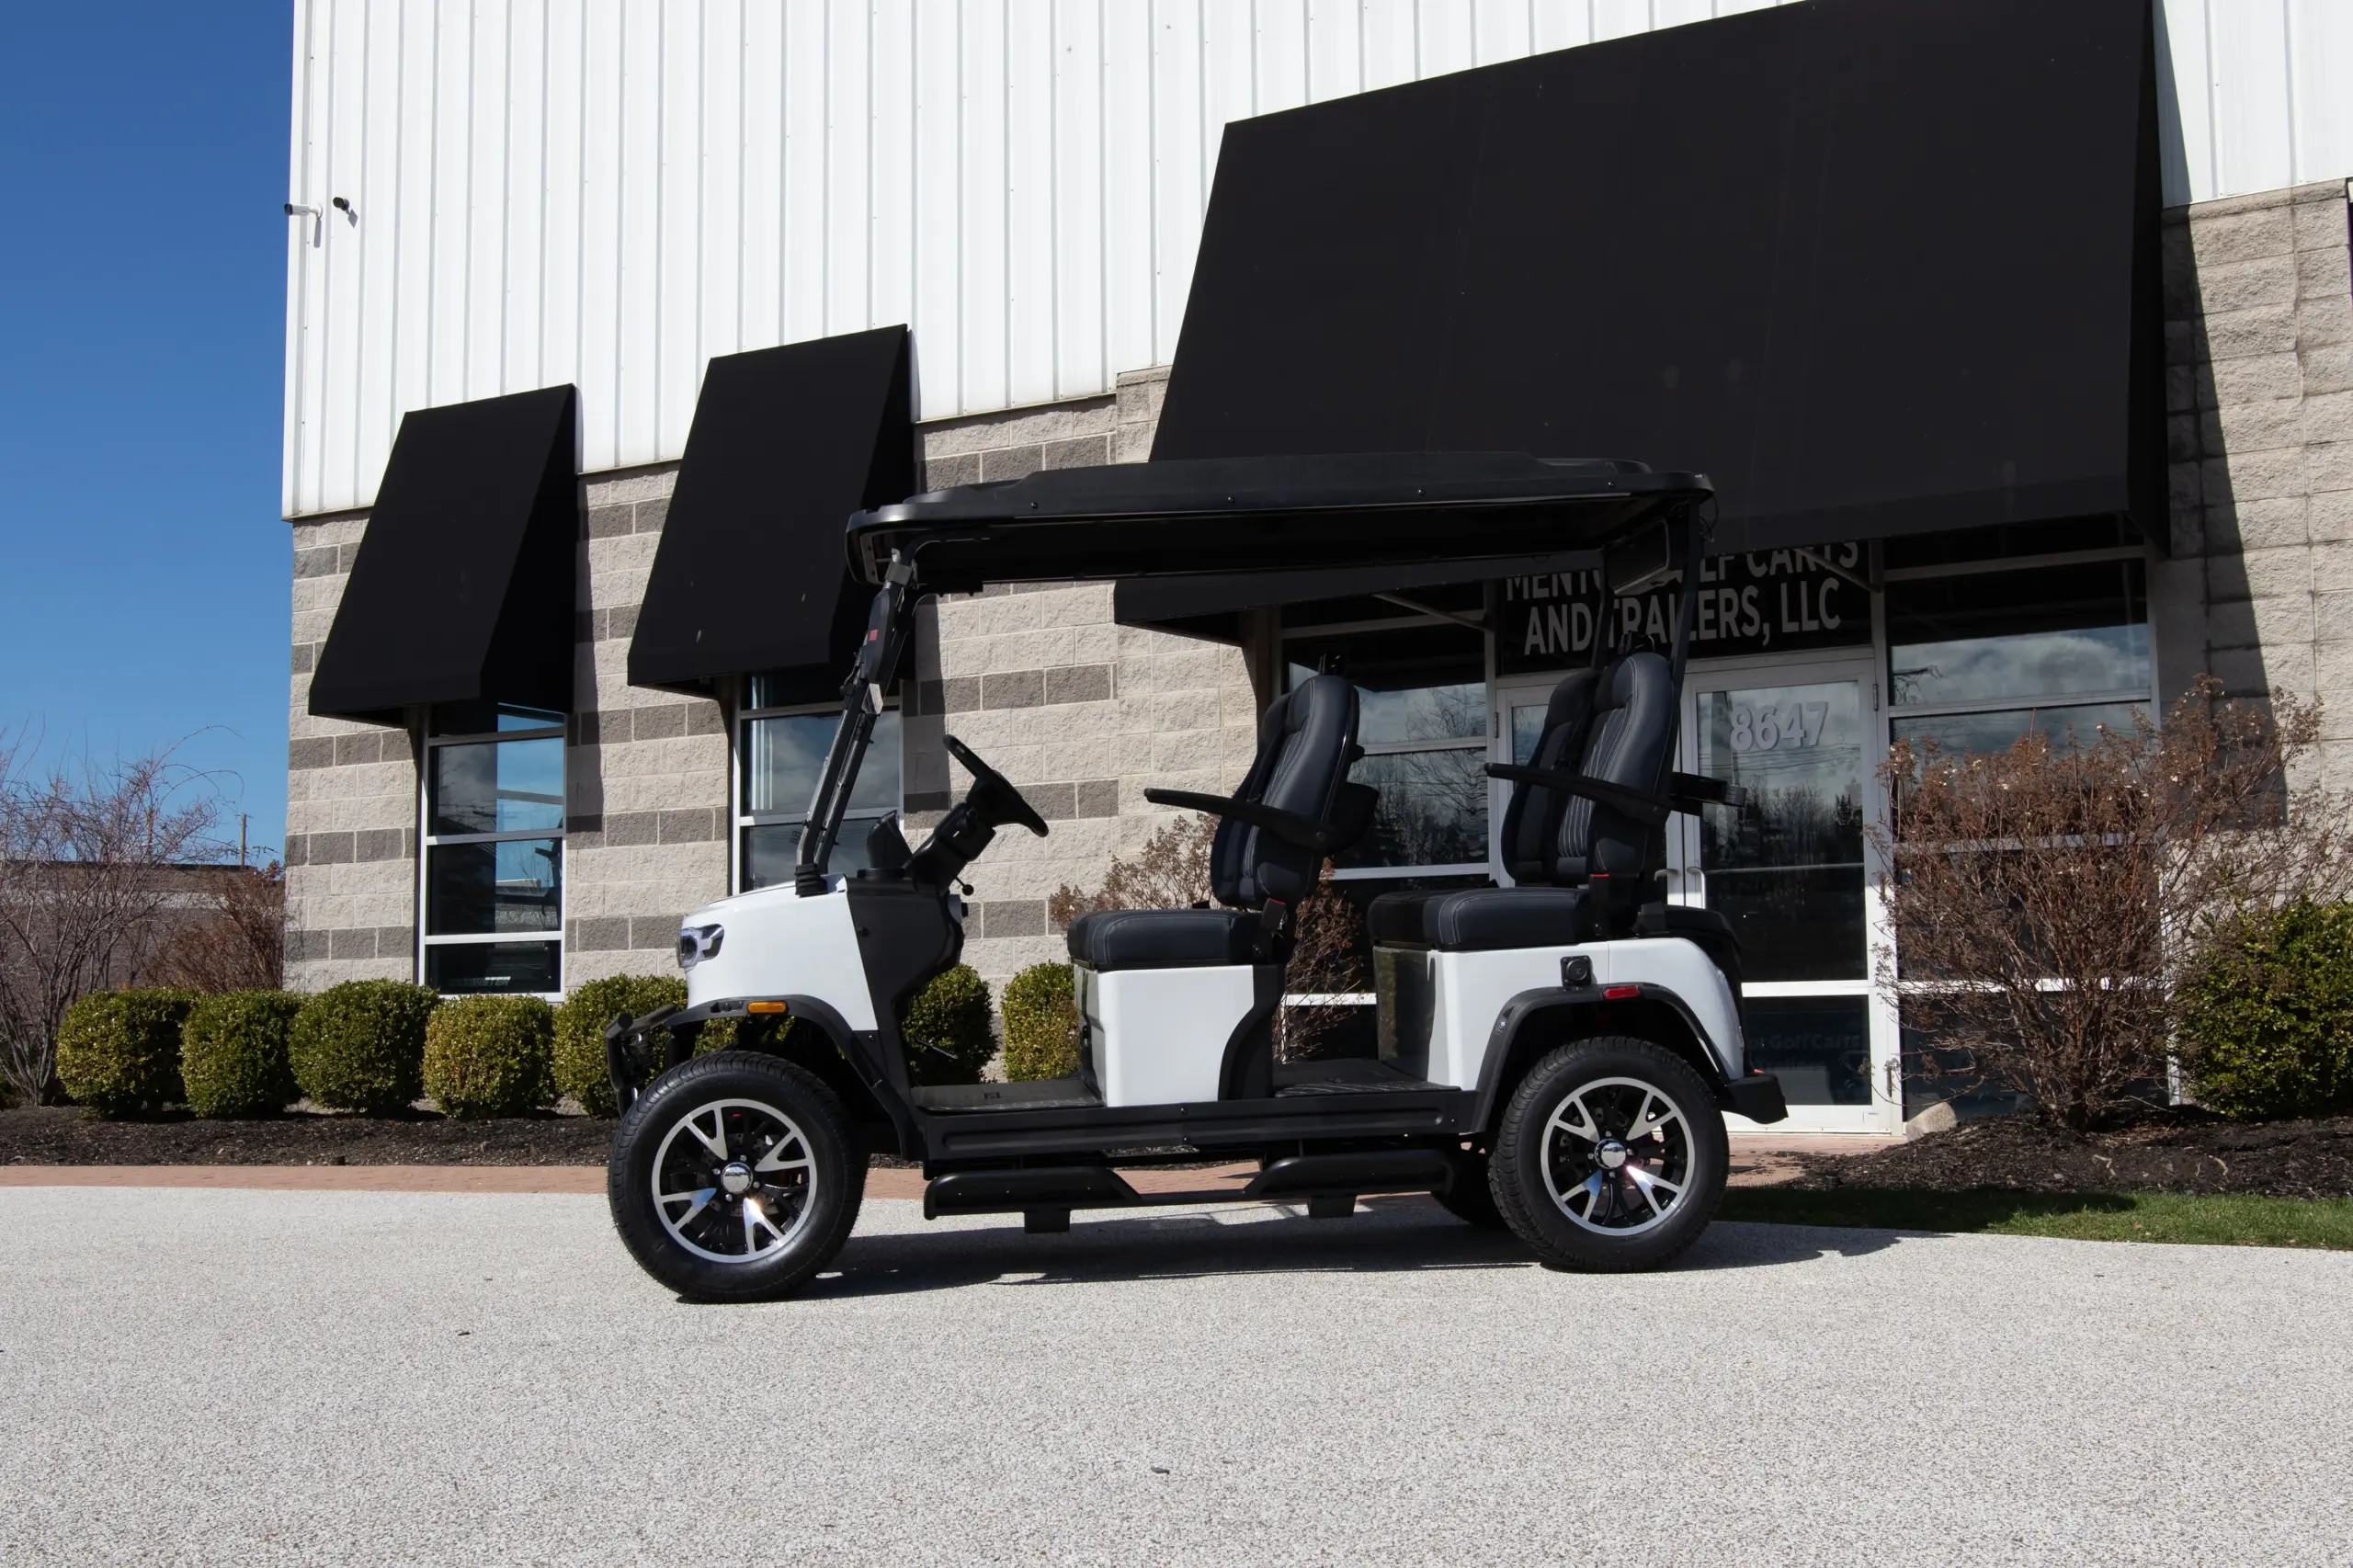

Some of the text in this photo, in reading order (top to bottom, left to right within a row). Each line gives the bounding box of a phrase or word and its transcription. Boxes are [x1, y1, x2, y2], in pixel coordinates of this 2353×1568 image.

[1524, 577, 1842, 655] AND RAIERS, LLC
[1730, 699, 1829, 752] 8647
